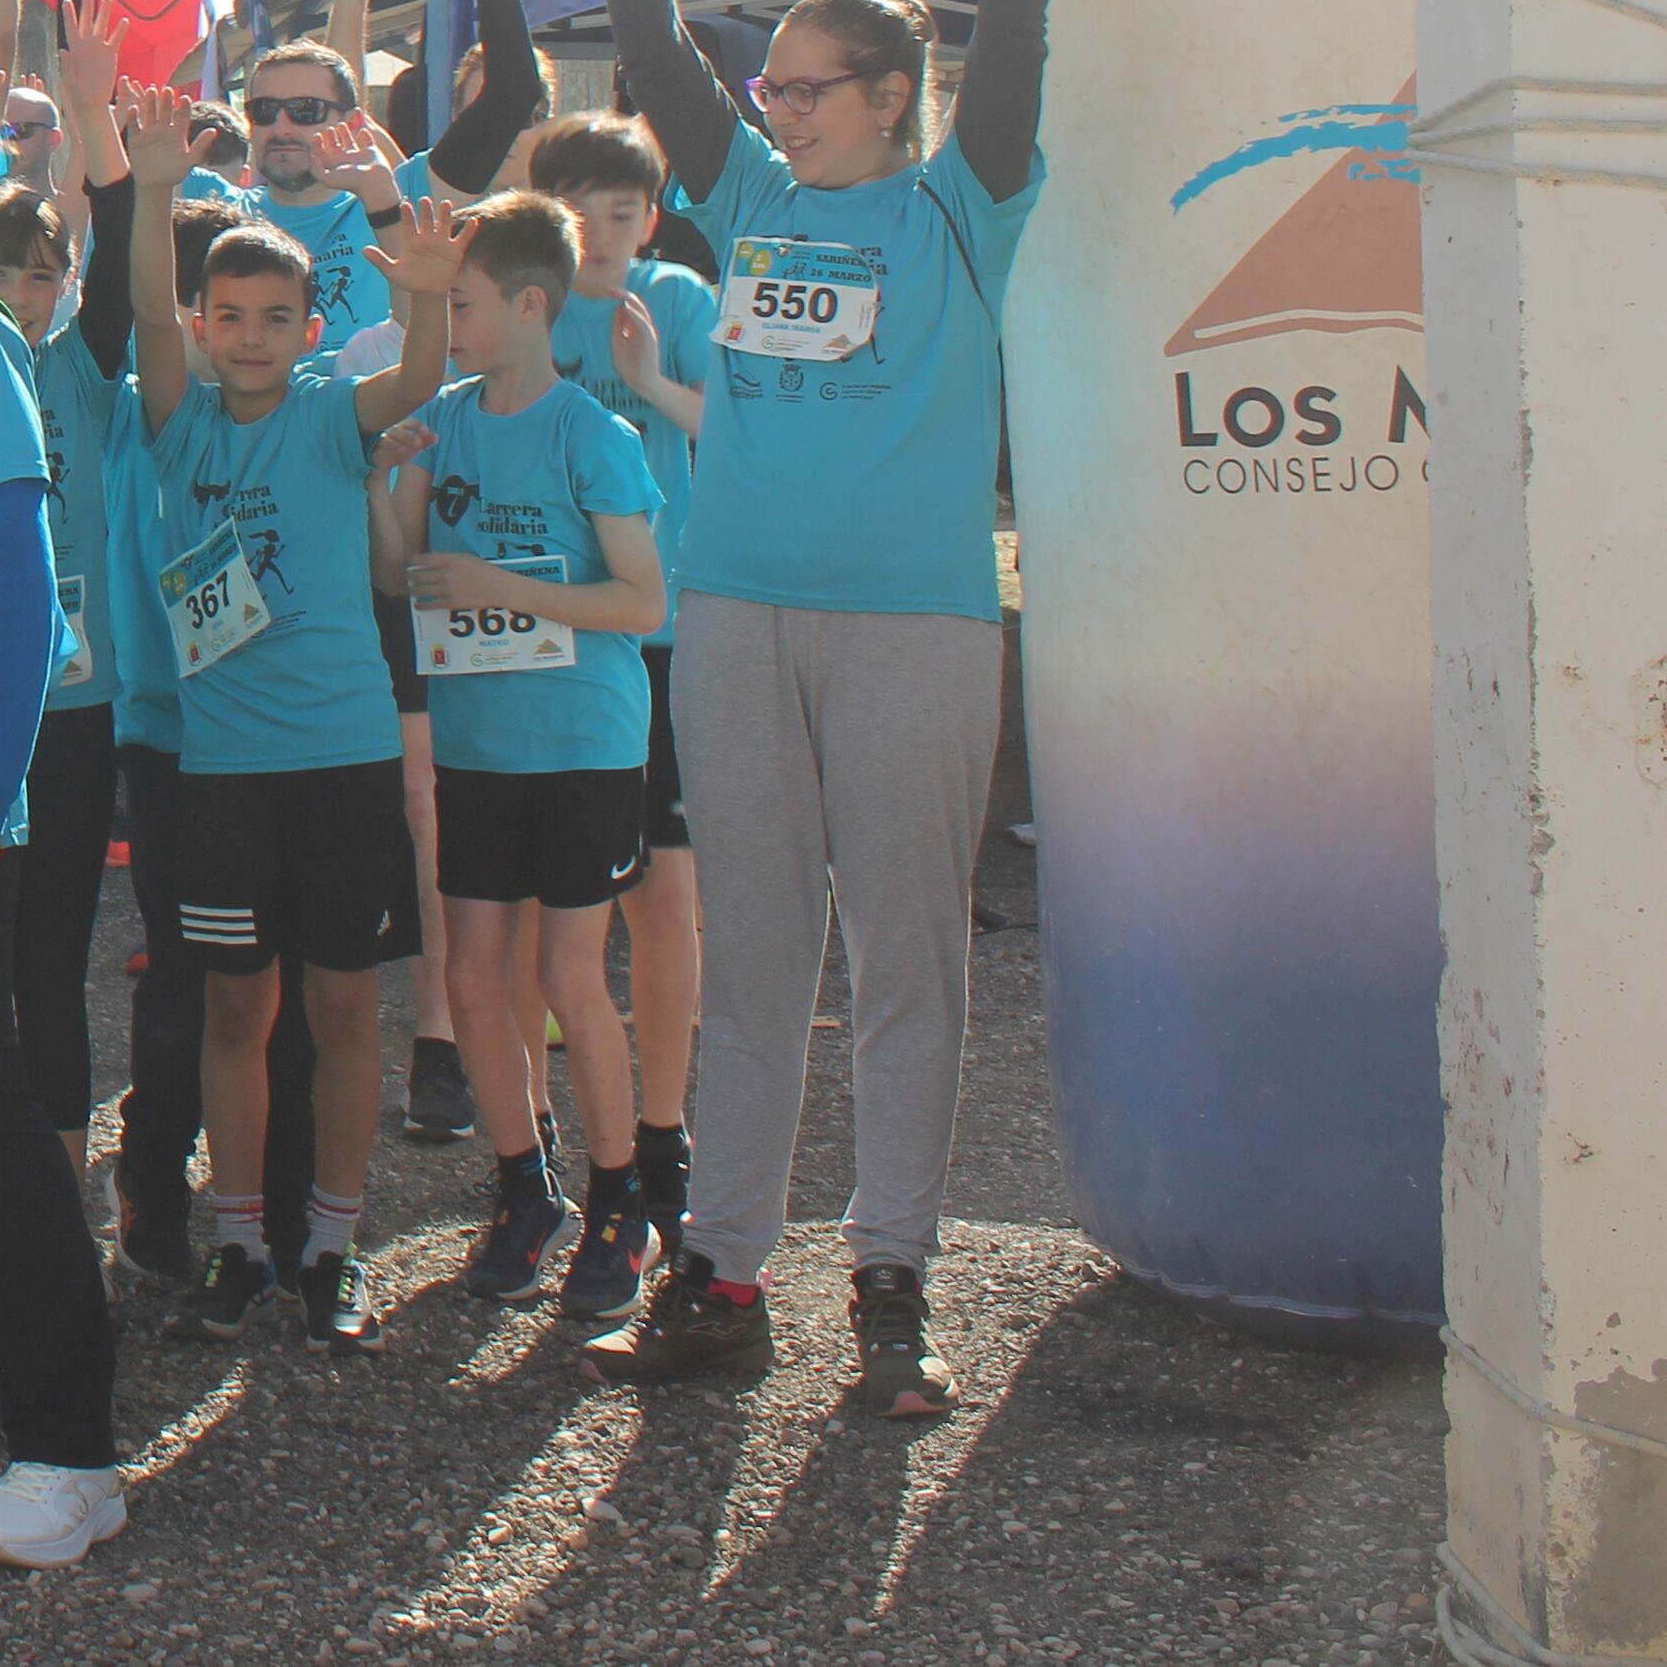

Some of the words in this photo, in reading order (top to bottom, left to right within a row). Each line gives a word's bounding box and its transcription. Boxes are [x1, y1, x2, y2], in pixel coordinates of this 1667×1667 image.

[752, 282, 838, 324] 550
[1175, 371, 1342, 448] Los
[1183, 455, 1400, 494] CONSEJO
[186, 570, 231, 630] 367
[448, 608, 536, 638] 568
